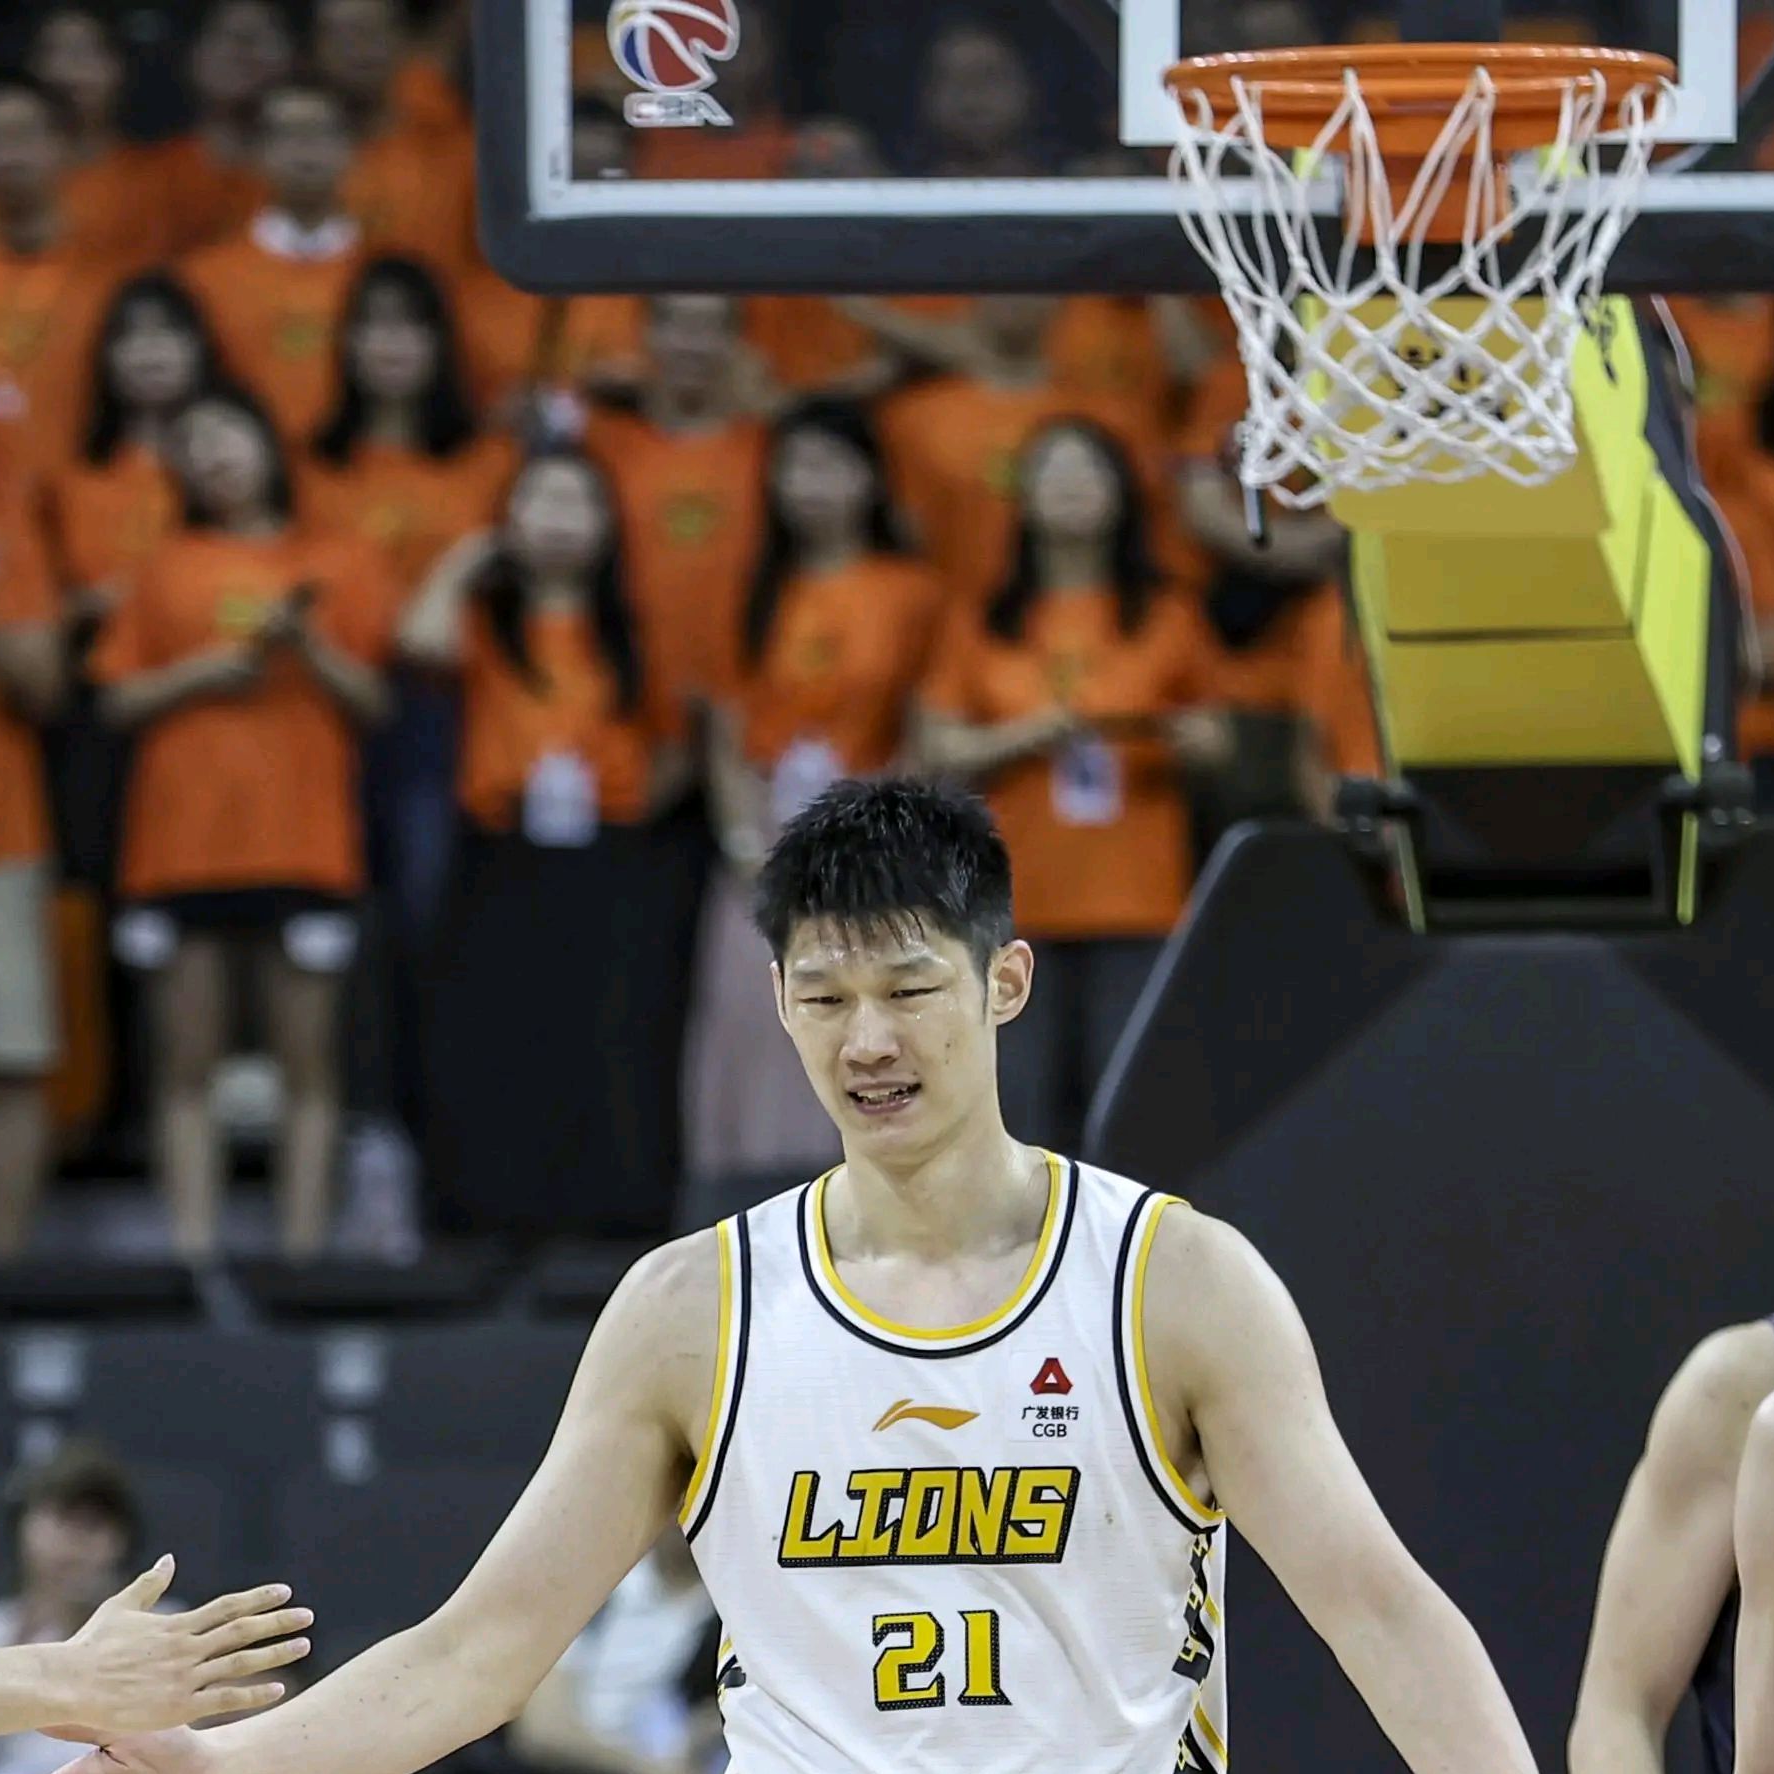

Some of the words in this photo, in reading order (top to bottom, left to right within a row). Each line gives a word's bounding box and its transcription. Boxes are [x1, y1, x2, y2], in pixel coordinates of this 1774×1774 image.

[1021, 1405, 1080, 1421] 广发银行
[1032, 1422, 1068, 1438] CGB
[777, 1466, 1082, 1569] LIONS
[871, 1609, 1014, 1712] 21
